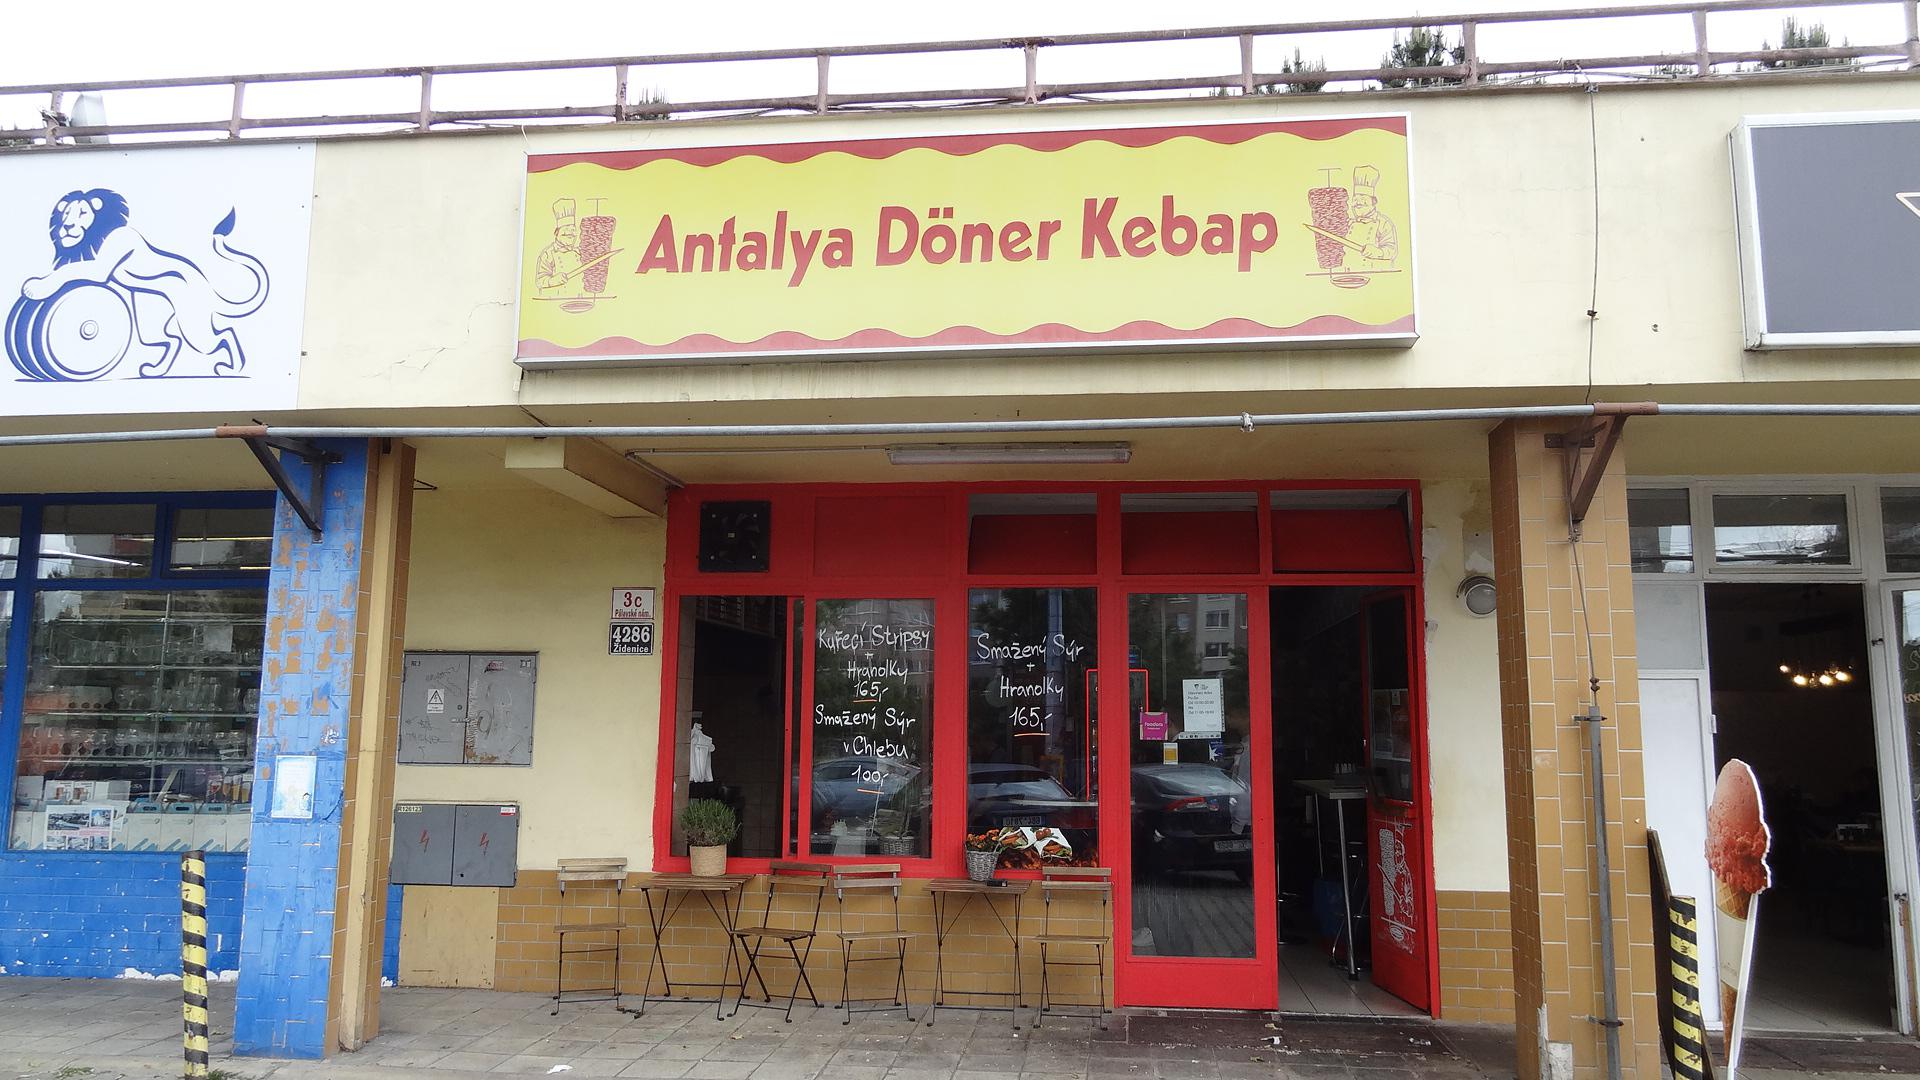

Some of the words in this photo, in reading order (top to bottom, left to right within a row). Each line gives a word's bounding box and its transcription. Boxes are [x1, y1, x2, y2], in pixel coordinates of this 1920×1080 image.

[635, 210, 853, 288] Antalya
[875, 205, 1062, 267] Döner
[1081, 195, 1279, 273] Kebap
[612, 626, 651, 643] 4286
[613, 642, 649, 653] Židenice
[871, 624, 931, 652] Stripsy
[976, 632, 1047, 663] Smažený
[1052, 633, 1085, 662] Sýr
[1026, 661, 1036, 672] +
[815, 704, 876, 730] Smažený
[884, 707, 916, 735] Sýr
[853, 735, 909, 759] Chlebu
